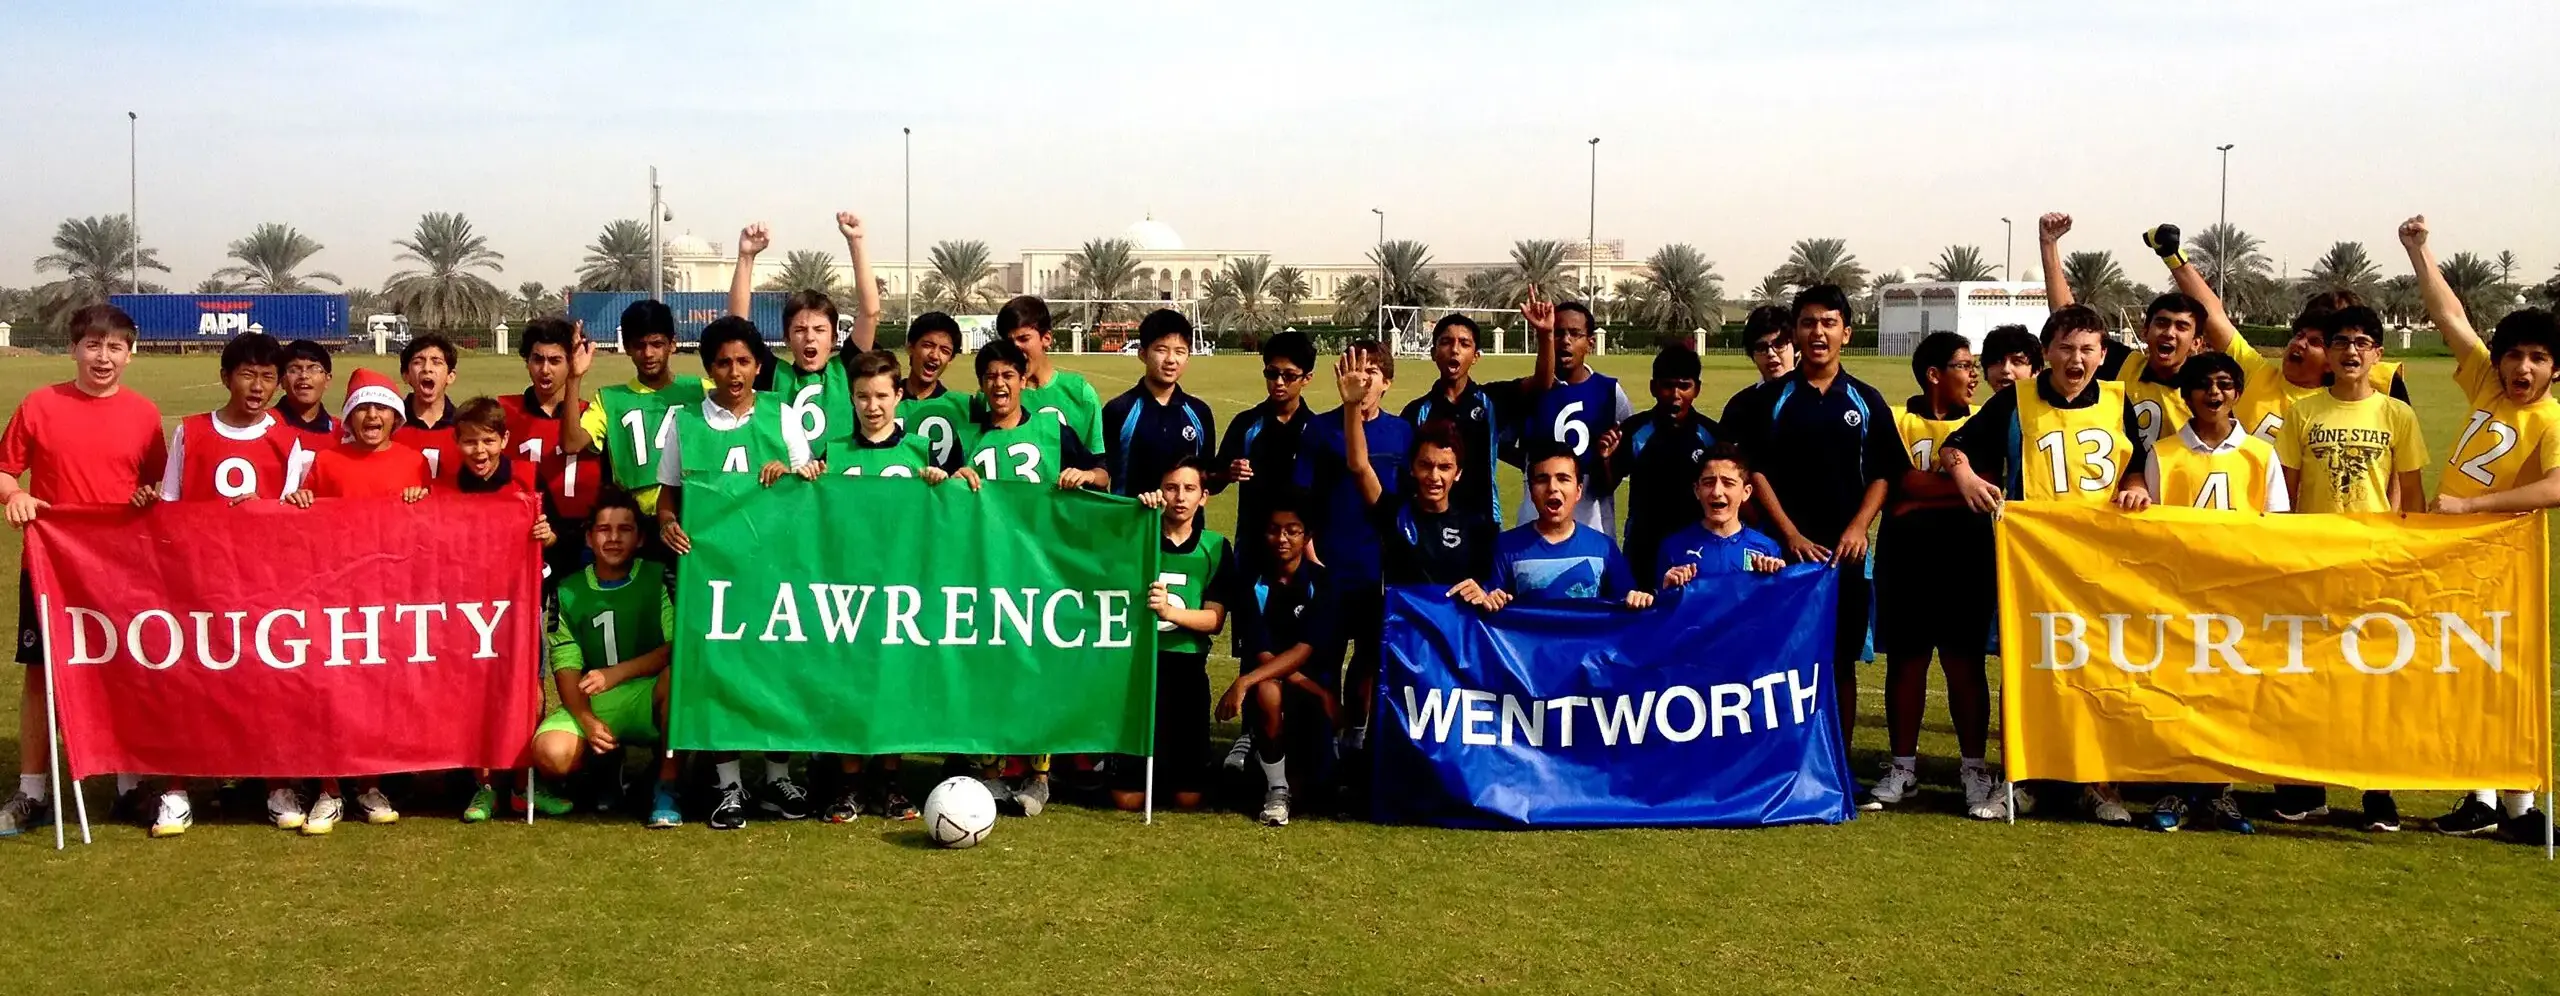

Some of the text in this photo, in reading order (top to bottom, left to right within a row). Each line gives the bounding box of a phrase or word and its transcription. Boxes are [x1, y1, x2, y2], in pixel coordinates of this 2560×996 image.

[791, 383, 827, 441] 6
[1554, 401, 1590, 456] 6
[2308, 428, 2391, 446] LONE STAR
[973, 442, 1042, 483] 13
[2036, 427, 2117, 494] 13
[2449, 409, 2518, 486] 12
[1442, 528, 1462, 549] 5
[65, 600, 511, 670] DOUGHTY
[592, 610, 619, 666] 1
[705, 580, 1132, 648] LAWRENCE
[2030, 610, 2512, 675] BURTON
[1404, 663, 1819, 747] WENTWORTH
